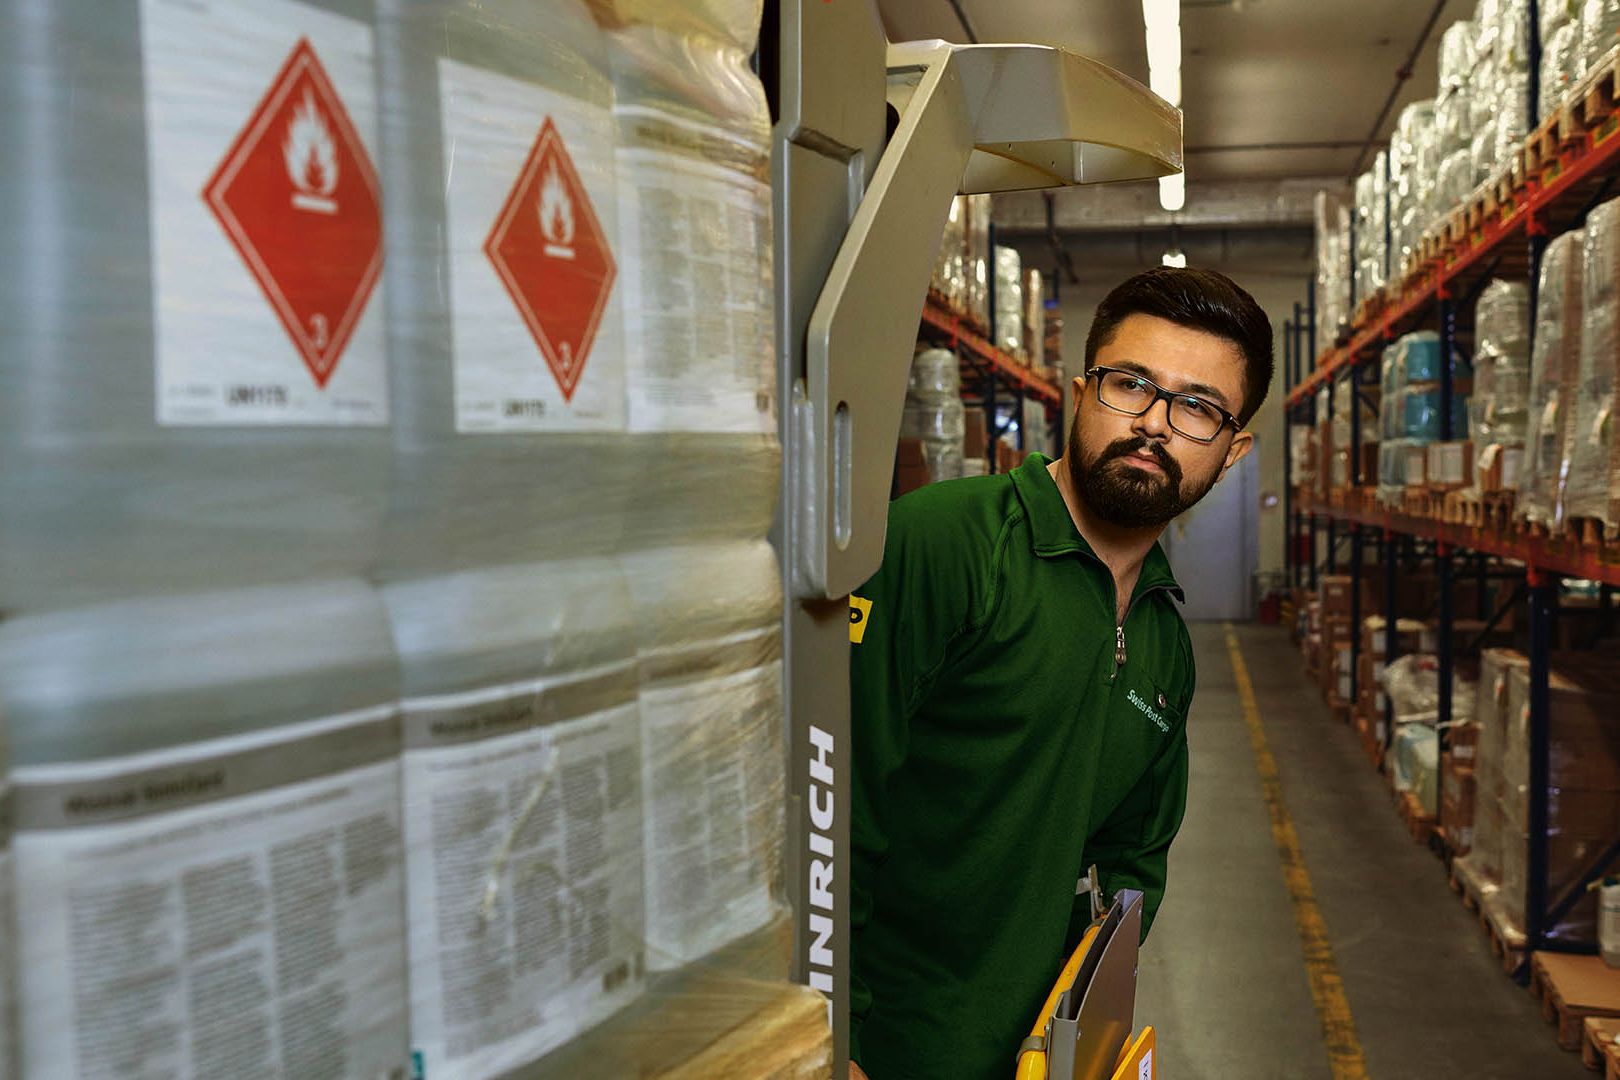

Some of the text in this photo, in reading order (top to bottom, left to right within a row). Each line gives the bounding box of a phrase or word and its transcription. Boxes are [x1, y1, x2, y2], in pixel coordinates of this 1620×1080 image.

[310, 314, 328, 346] 3
[559, 341, 571, 369] 3
[1127, 689, 1170, 733] Swiss Post Cargo
[809, 725, 834, 1029] INRICH
